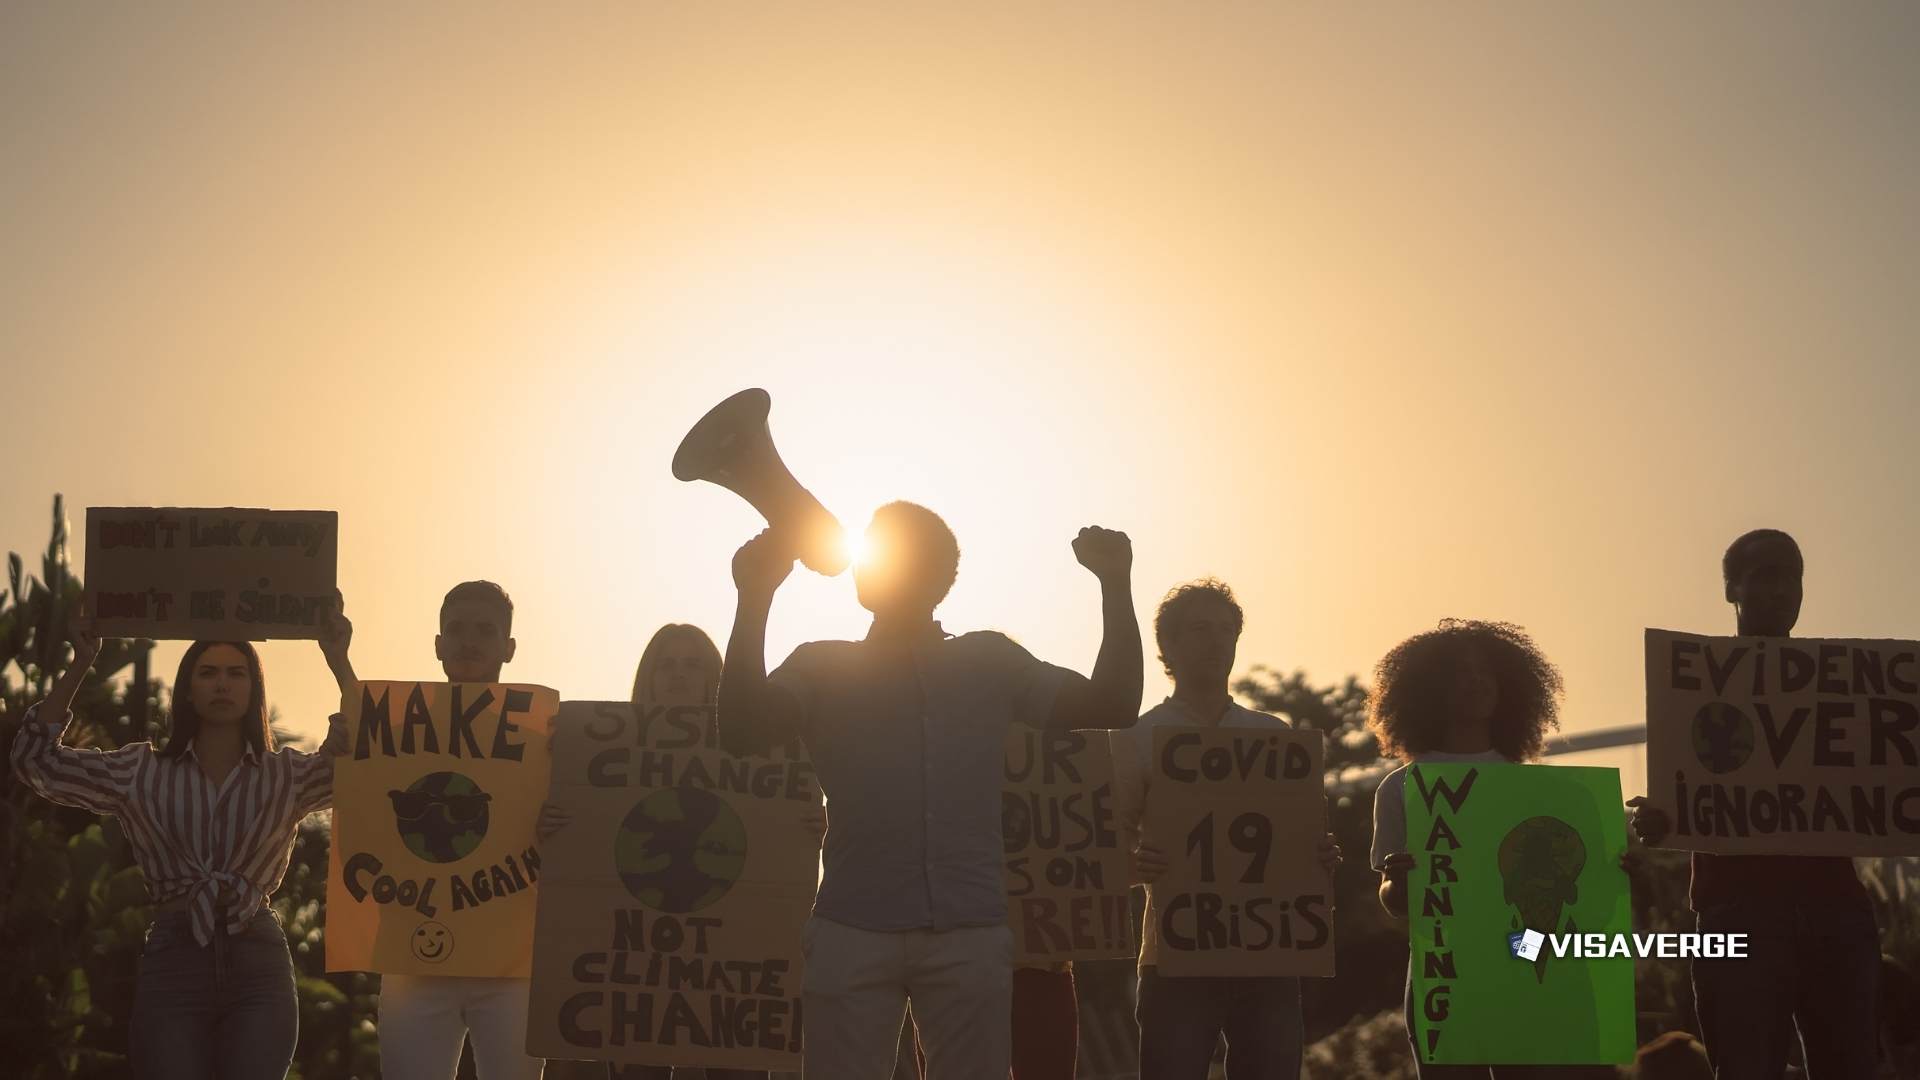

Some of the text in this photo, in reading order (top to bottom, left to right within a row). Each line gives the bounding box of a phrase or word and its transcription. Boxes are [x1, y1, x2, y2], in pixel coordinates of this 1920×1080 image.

[1671, 640, 1919, 696] EViDENC
[354, 682, 533, 763] MAKE
[587, 748, 816, 801] CHANGE
[1003, 731, 1087, 784] UR
[1002, 783, 1118, 853] OUSE
[1675, 769, 1920, 838] iGNORANC
[1006, 856, 1105, 897] S ON
[1187, 811, 1273, 884] 19
[612, 908, 723, 954] NOT
[1021, 896, 1128, 955] RE!!
[558, 989, 802, 1054] CHANGE!
